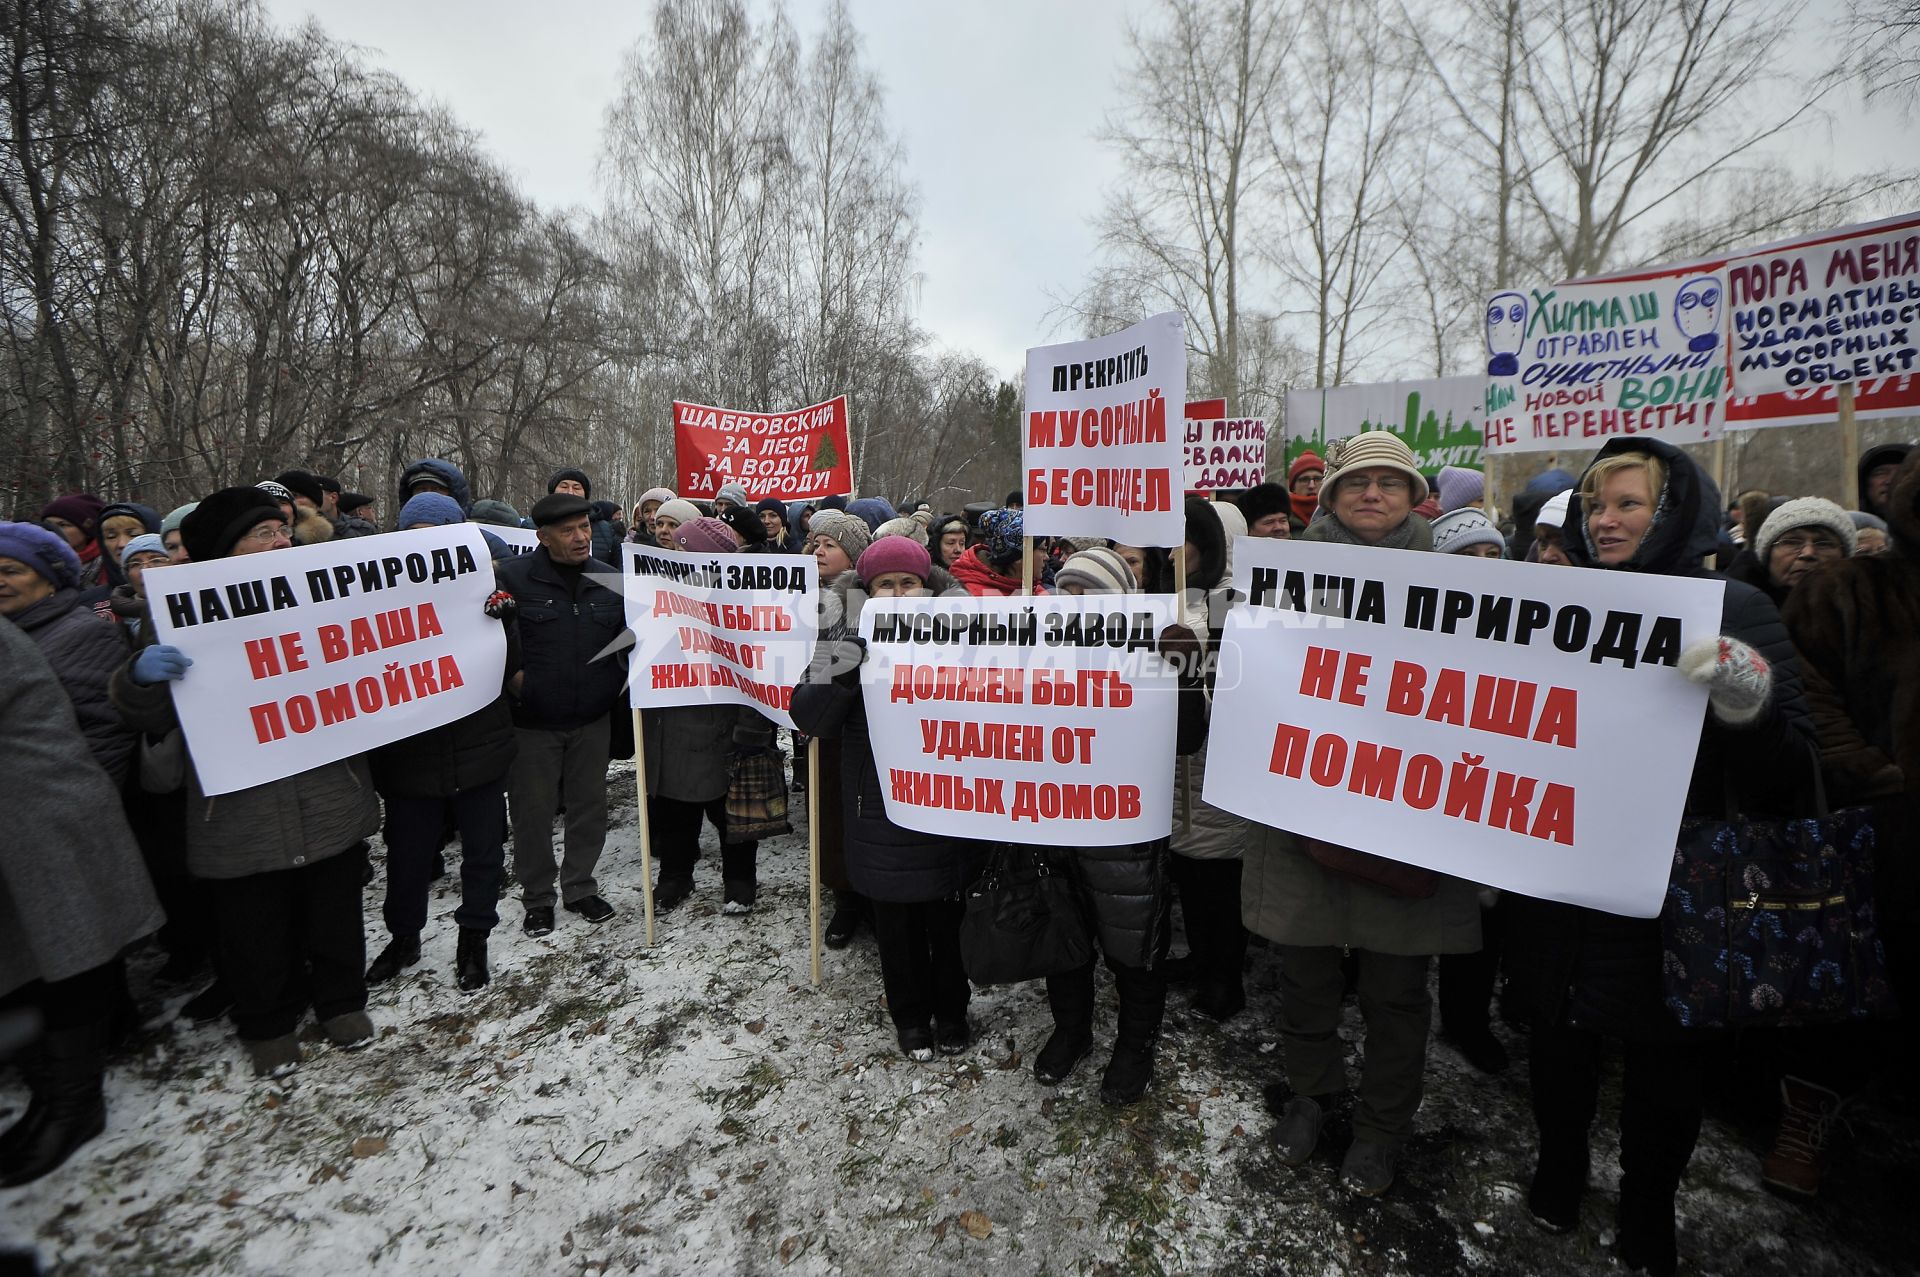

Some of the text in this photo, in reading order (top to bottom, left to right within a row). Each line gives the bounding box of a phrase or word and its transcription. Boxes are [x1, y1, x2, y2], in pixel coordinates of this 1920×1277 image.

[1730, 257, 1808, 306] ПОРА
[1537, 327, 1660, 359] ОТРАВЛЕН
[1740, 328, 1909, 372] МУСОРНЫХ
[1052, 345, 1148, 392] ПРЕКРАТИТЬ
[1522, 351, 1714, 388] ОЧИСТНЫМИ
[1525, 382, 1605, 412] НОВОЙ
[1618, 366, 1725, 410] ВОНИ
[1029, 388, 1167, 448] МУСОРНЫЙ
[1213, 419, 1265, 441] ПРОТИВ
[1484, 402, 1717, 448] НЕ ПЕРЕНЕСТИ!
[705, 454, 809, 477] ЗА ВОДУ!
[722, 434, 808, 456] ЗА ЛЕС!
[688, 473, 714, 491] ЗА
[1028, 468, 1171, 517] БЕСПРЕДЕЛ
[166, 575, 299, 629] НАША
[305, 545, 478, 603] ПРИРОДА
[634, 554, 807, 594] МУСОРНЫЙ ЗАВОД
[653, 590, 792, 632] ДОЛЖЕН БЫТЬ
[872, 606, 1155, 653] МУСОРНЫЙ ЗАВОД
[1250, 566, 1682, 669] НАША ПРИРОДА
[244, 602, 444, 680] НЕ ВАША
[678, 627, 766, 670] УДАЛЕН ОТ
[249, 654, 465, 744] ПОМОЙКА
[651, 663, 794, 711] ЖИЛЫХ ДОМОВ
[891, 664, 1133, 708] ДОЛЖЕН БЫТЬ
[1299, 646, 1578, 749] НЕ ВАША
[920, 719, 1096, 764] УДАЛЕН ОТ
[889, 768, 1142, 823] ЖИЛЫХ ДОМОВ
[1269, 722, 1575, 846] ПОМОЙКА
